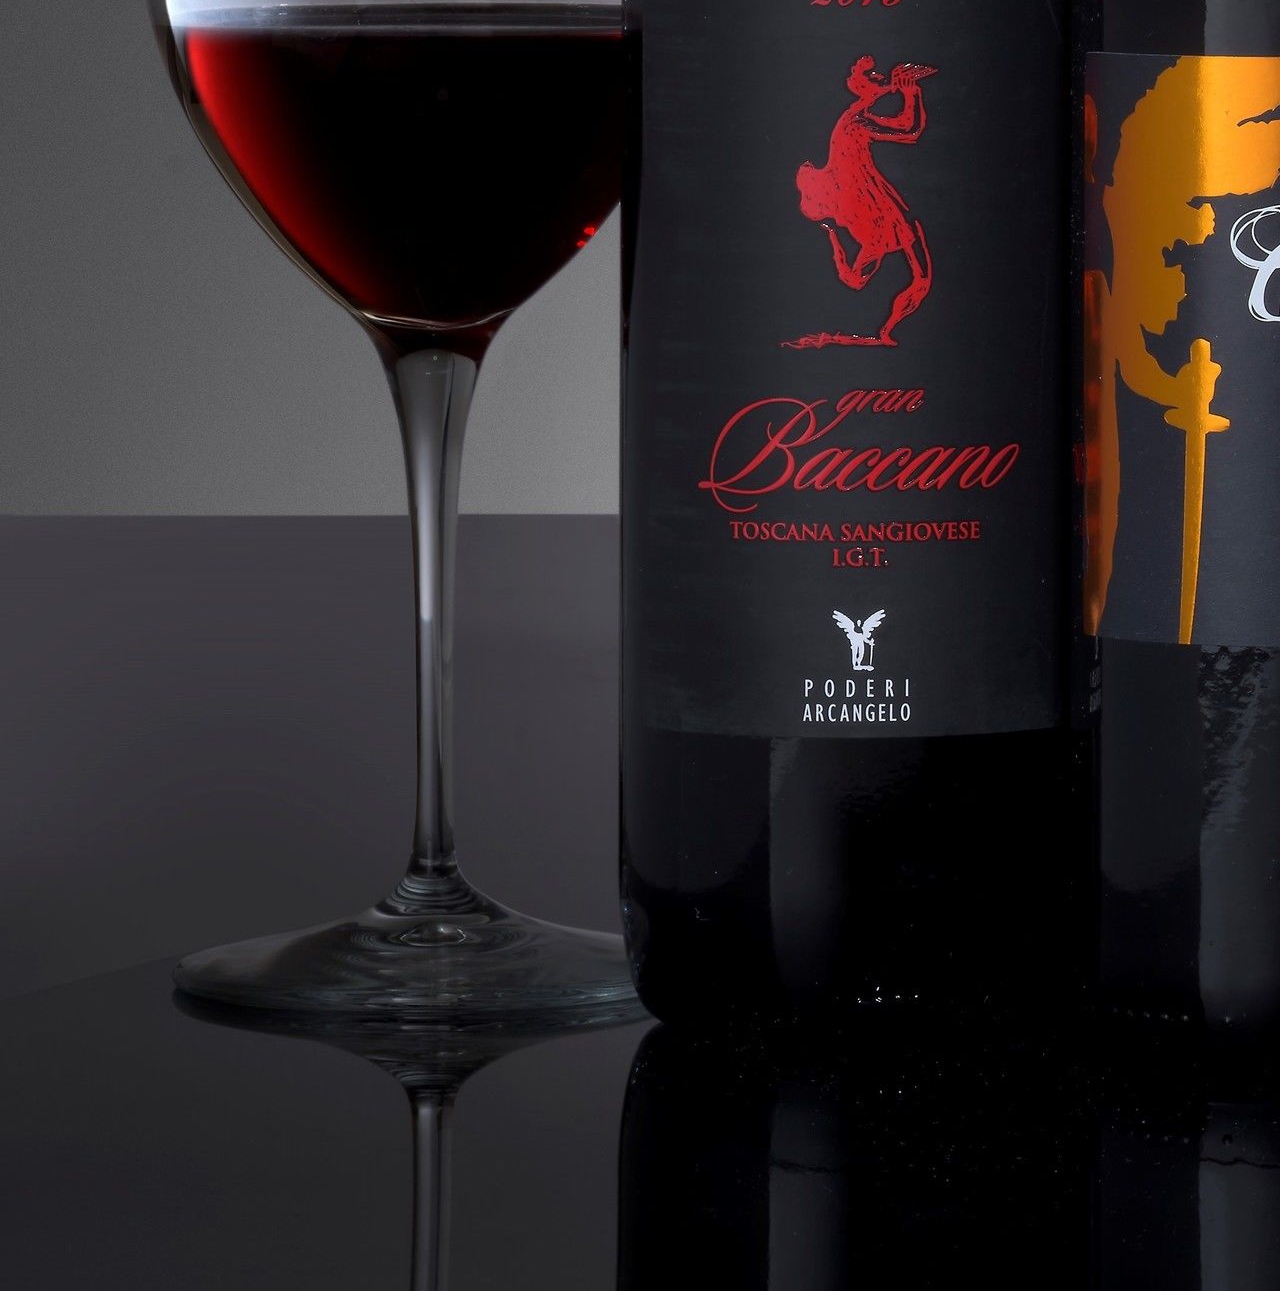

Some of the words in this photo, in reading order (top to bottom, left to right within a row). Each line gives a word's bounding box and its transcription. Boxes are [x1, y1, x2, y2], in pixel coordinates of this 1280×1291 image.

[835, 388, 925, 415] gran
[699, 397, 1020, 513] Baccano
[730, 522, 835, 542] TOSCANA
[840, 521, 981, 541] SANGIOVESE
[832, 547, 889, 568] I.G.T.
[804, 678, 910, 698] PODERI
[802, 703, 912, 723] ARCANGELO
